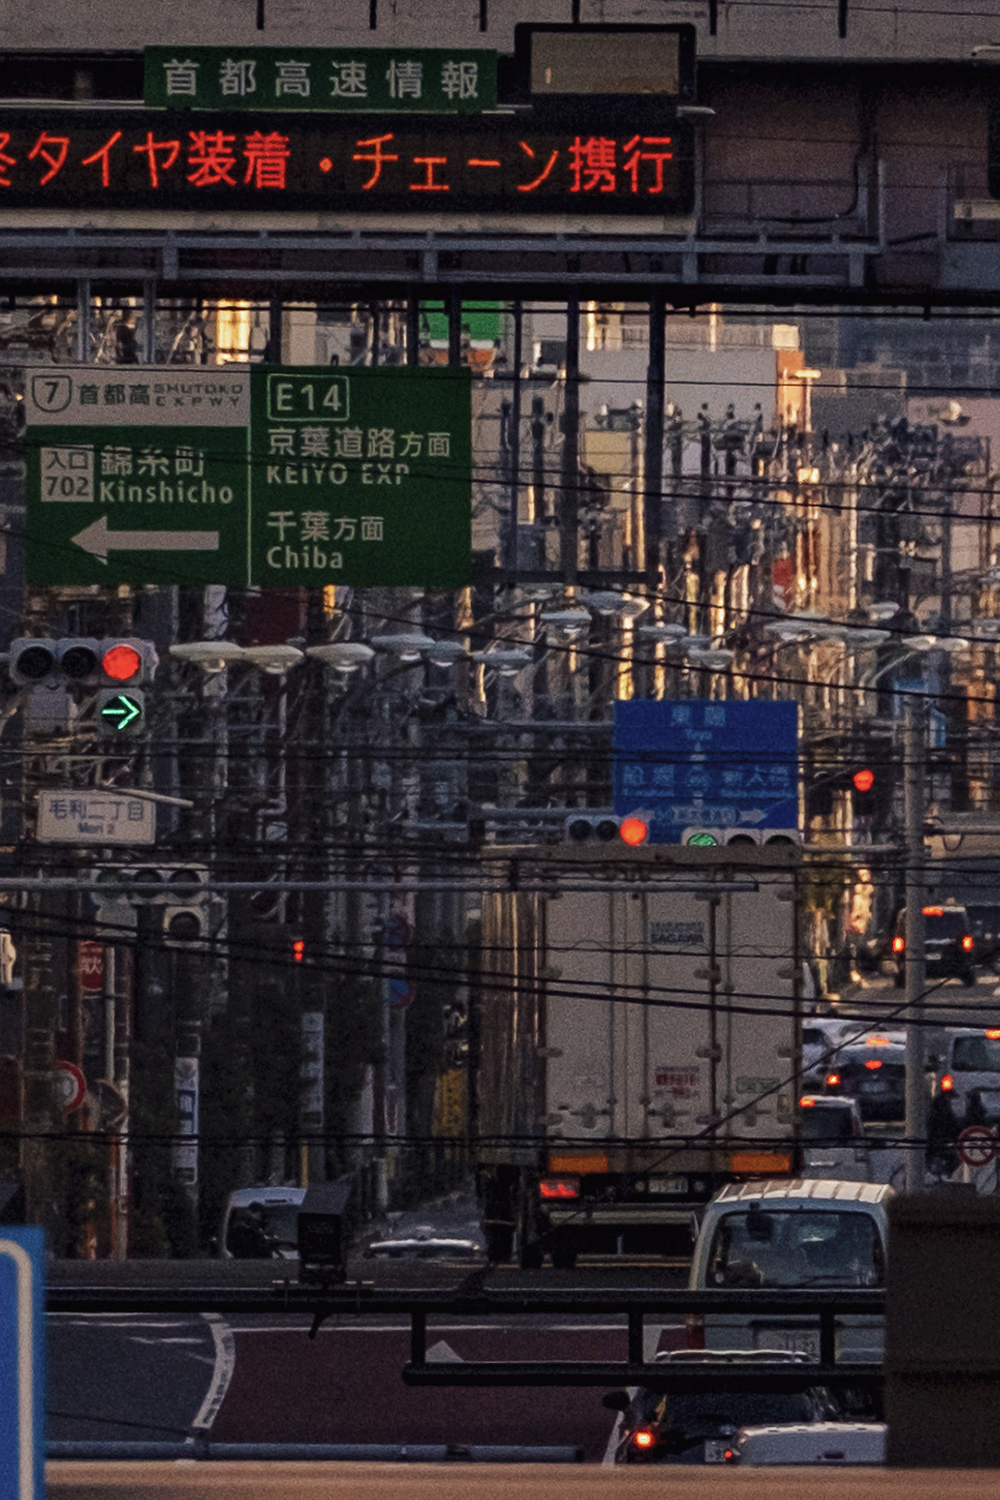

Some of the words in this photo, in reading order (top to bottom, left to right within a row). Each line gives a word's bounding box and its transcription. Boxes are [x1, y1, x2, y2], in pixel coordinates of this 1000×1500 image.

[162, 58, 481, 100] 首都高速情報
[43, 381, 60, 405] 7
[77, 383, 151, 406] 首都高
[153, 383, 243, 395] SHUTOKO
[276, 384, 342, 411] E14
[155, 397, 240, 407] EXPWY
[267, 426, 451, 458] 京葉道路方面
[45, 451, 89, 471] 入口
[100, 445, 205, 477] 錦糸町
[266, 462, 348, 485] KEIYO
[361, 462, 410, 485] EXP
[45, 475, 90, 497] 702
[100, 480, 234, 504] Kinshicho
[266, 510, 385, 542] 千葉方面
[266, 546, 343, 569] Chiba
[49, 800, 145, 821] 毛利二丁目
